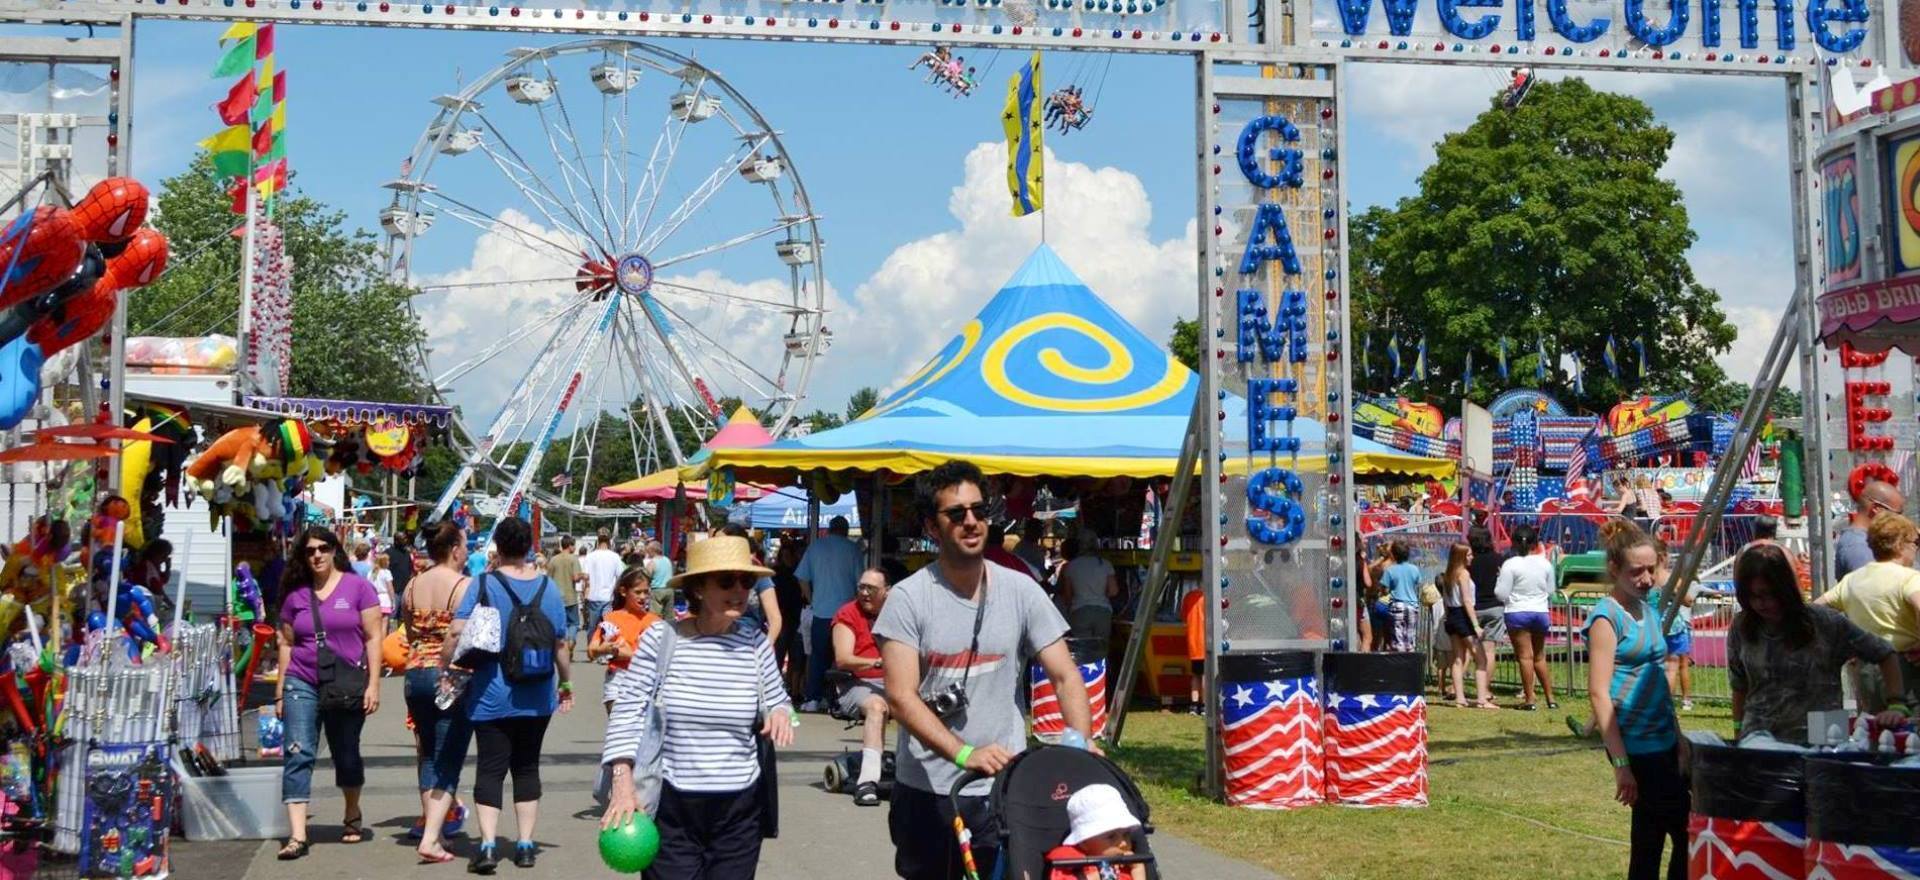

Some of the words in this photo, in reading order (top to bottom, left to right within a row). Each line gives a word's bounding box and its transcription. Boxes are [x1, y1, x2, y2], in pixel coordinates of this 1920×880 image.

[1236, 115, 1308, 545] GAMES
[781, 507, 859, 525] Airrs
[88, 748, 142, 766] SWAT
